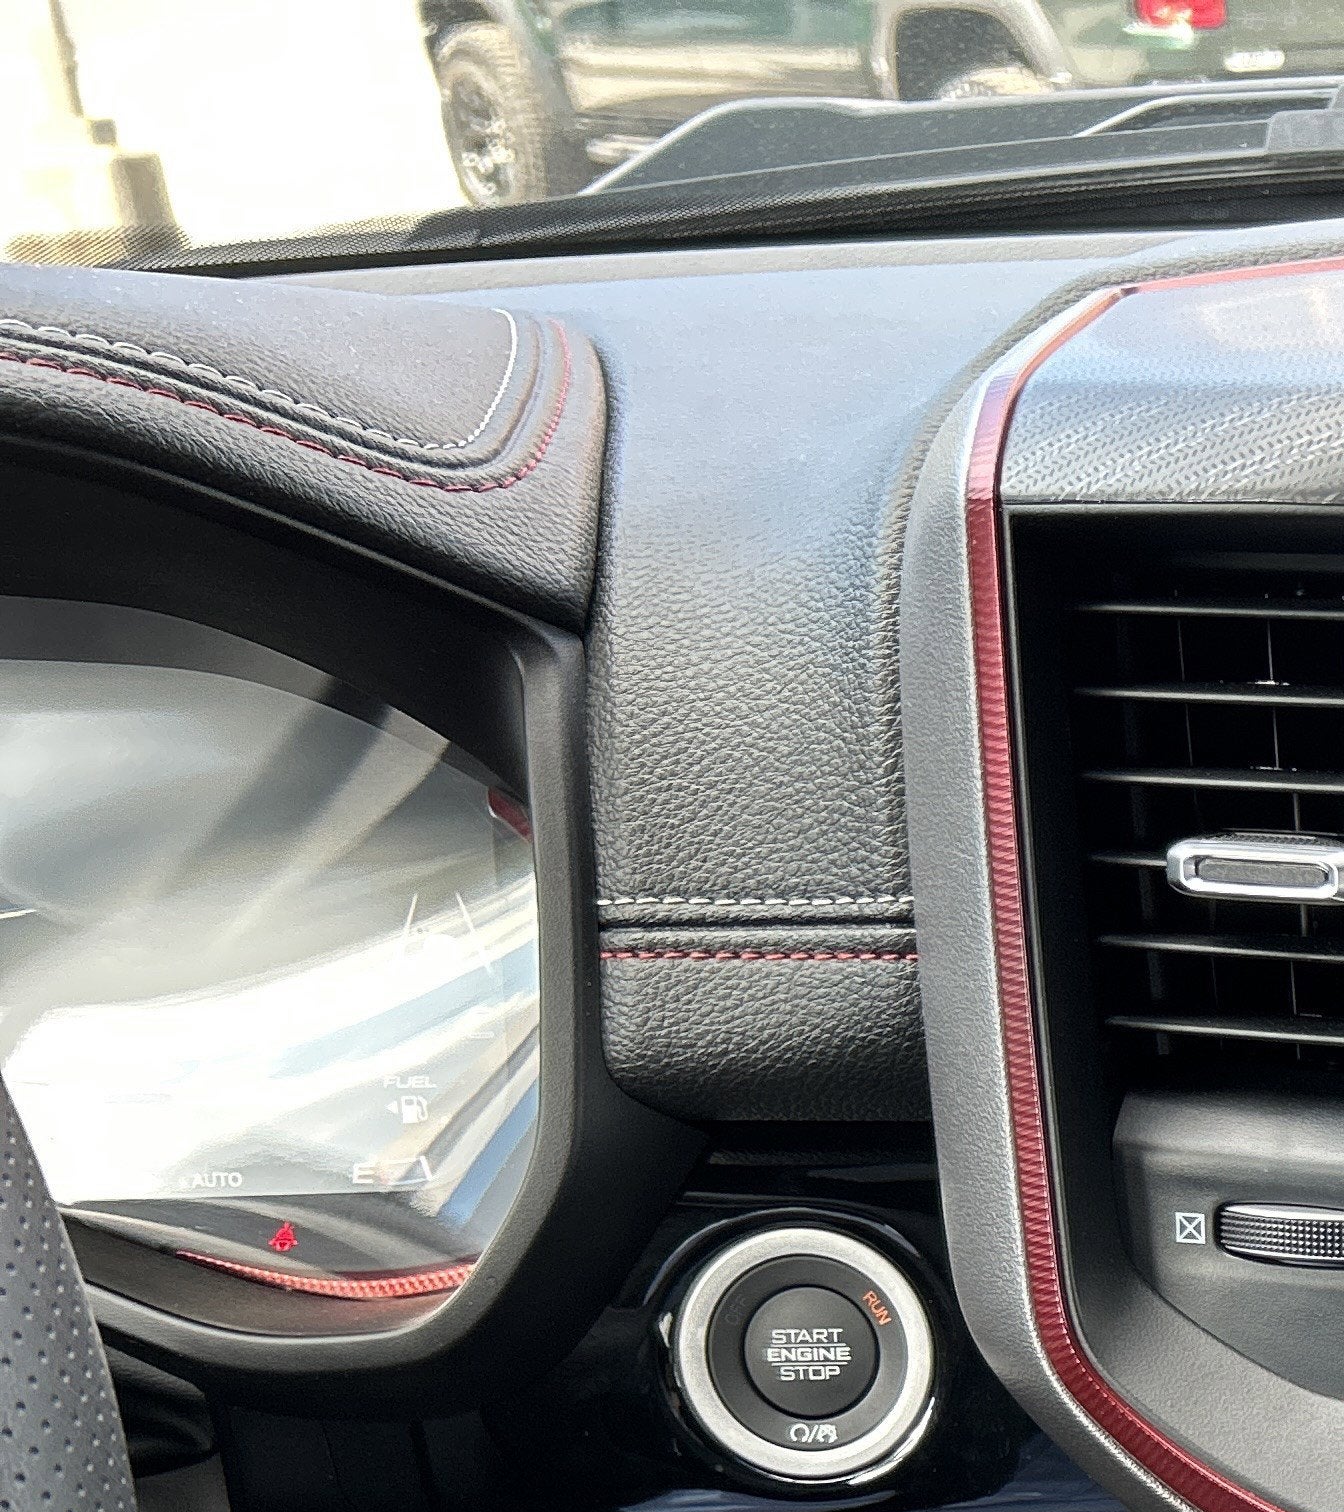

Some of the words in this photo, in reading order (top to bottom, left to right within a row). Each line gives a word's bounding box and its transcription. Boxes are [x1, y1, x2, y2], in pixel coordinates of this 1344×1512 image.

[192, 1170, 244, 1190] AUTO
[861, 1290, 892, 1327] RUN
[770, 1327, 845, 1345] START
[766, 1346, 852, 1363] ENGINE
[779, 1365, 842, 1382] STOP
